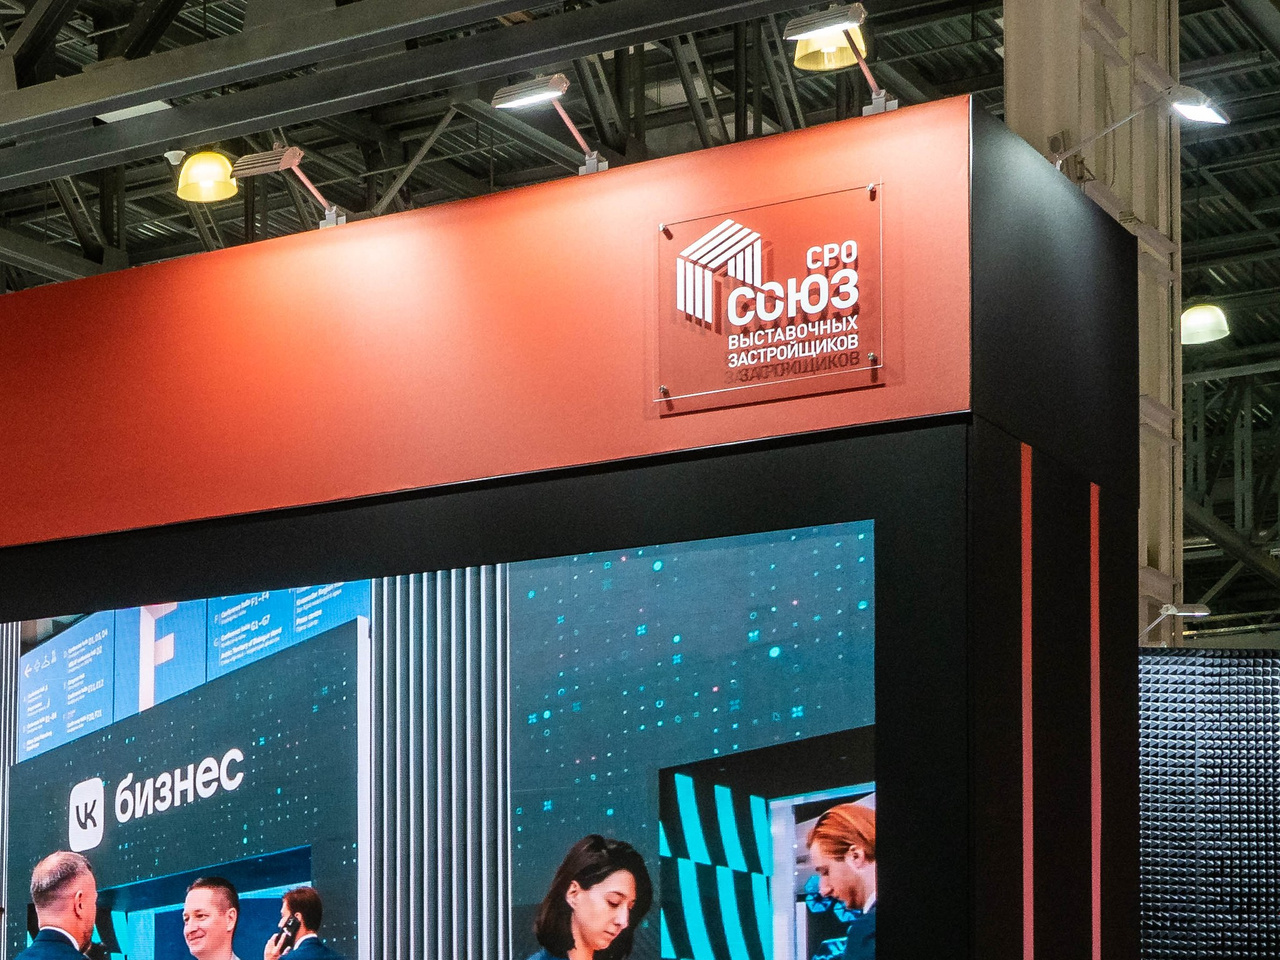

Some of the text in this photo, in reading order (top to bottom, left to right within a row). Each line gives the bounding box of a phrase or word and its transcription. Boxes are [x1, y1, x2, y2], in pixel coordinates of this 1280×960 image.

[806, 239, 858, 269] СРО
[727, 268, 859, 326] СОЮЗ
[728, 314, 858, 350] ВЫСТАВОЧНЫХ
[727, 333, 859, 368] ЗАСТРОЙЩИКОВ
[114, 748, 244, 823] бизнес
